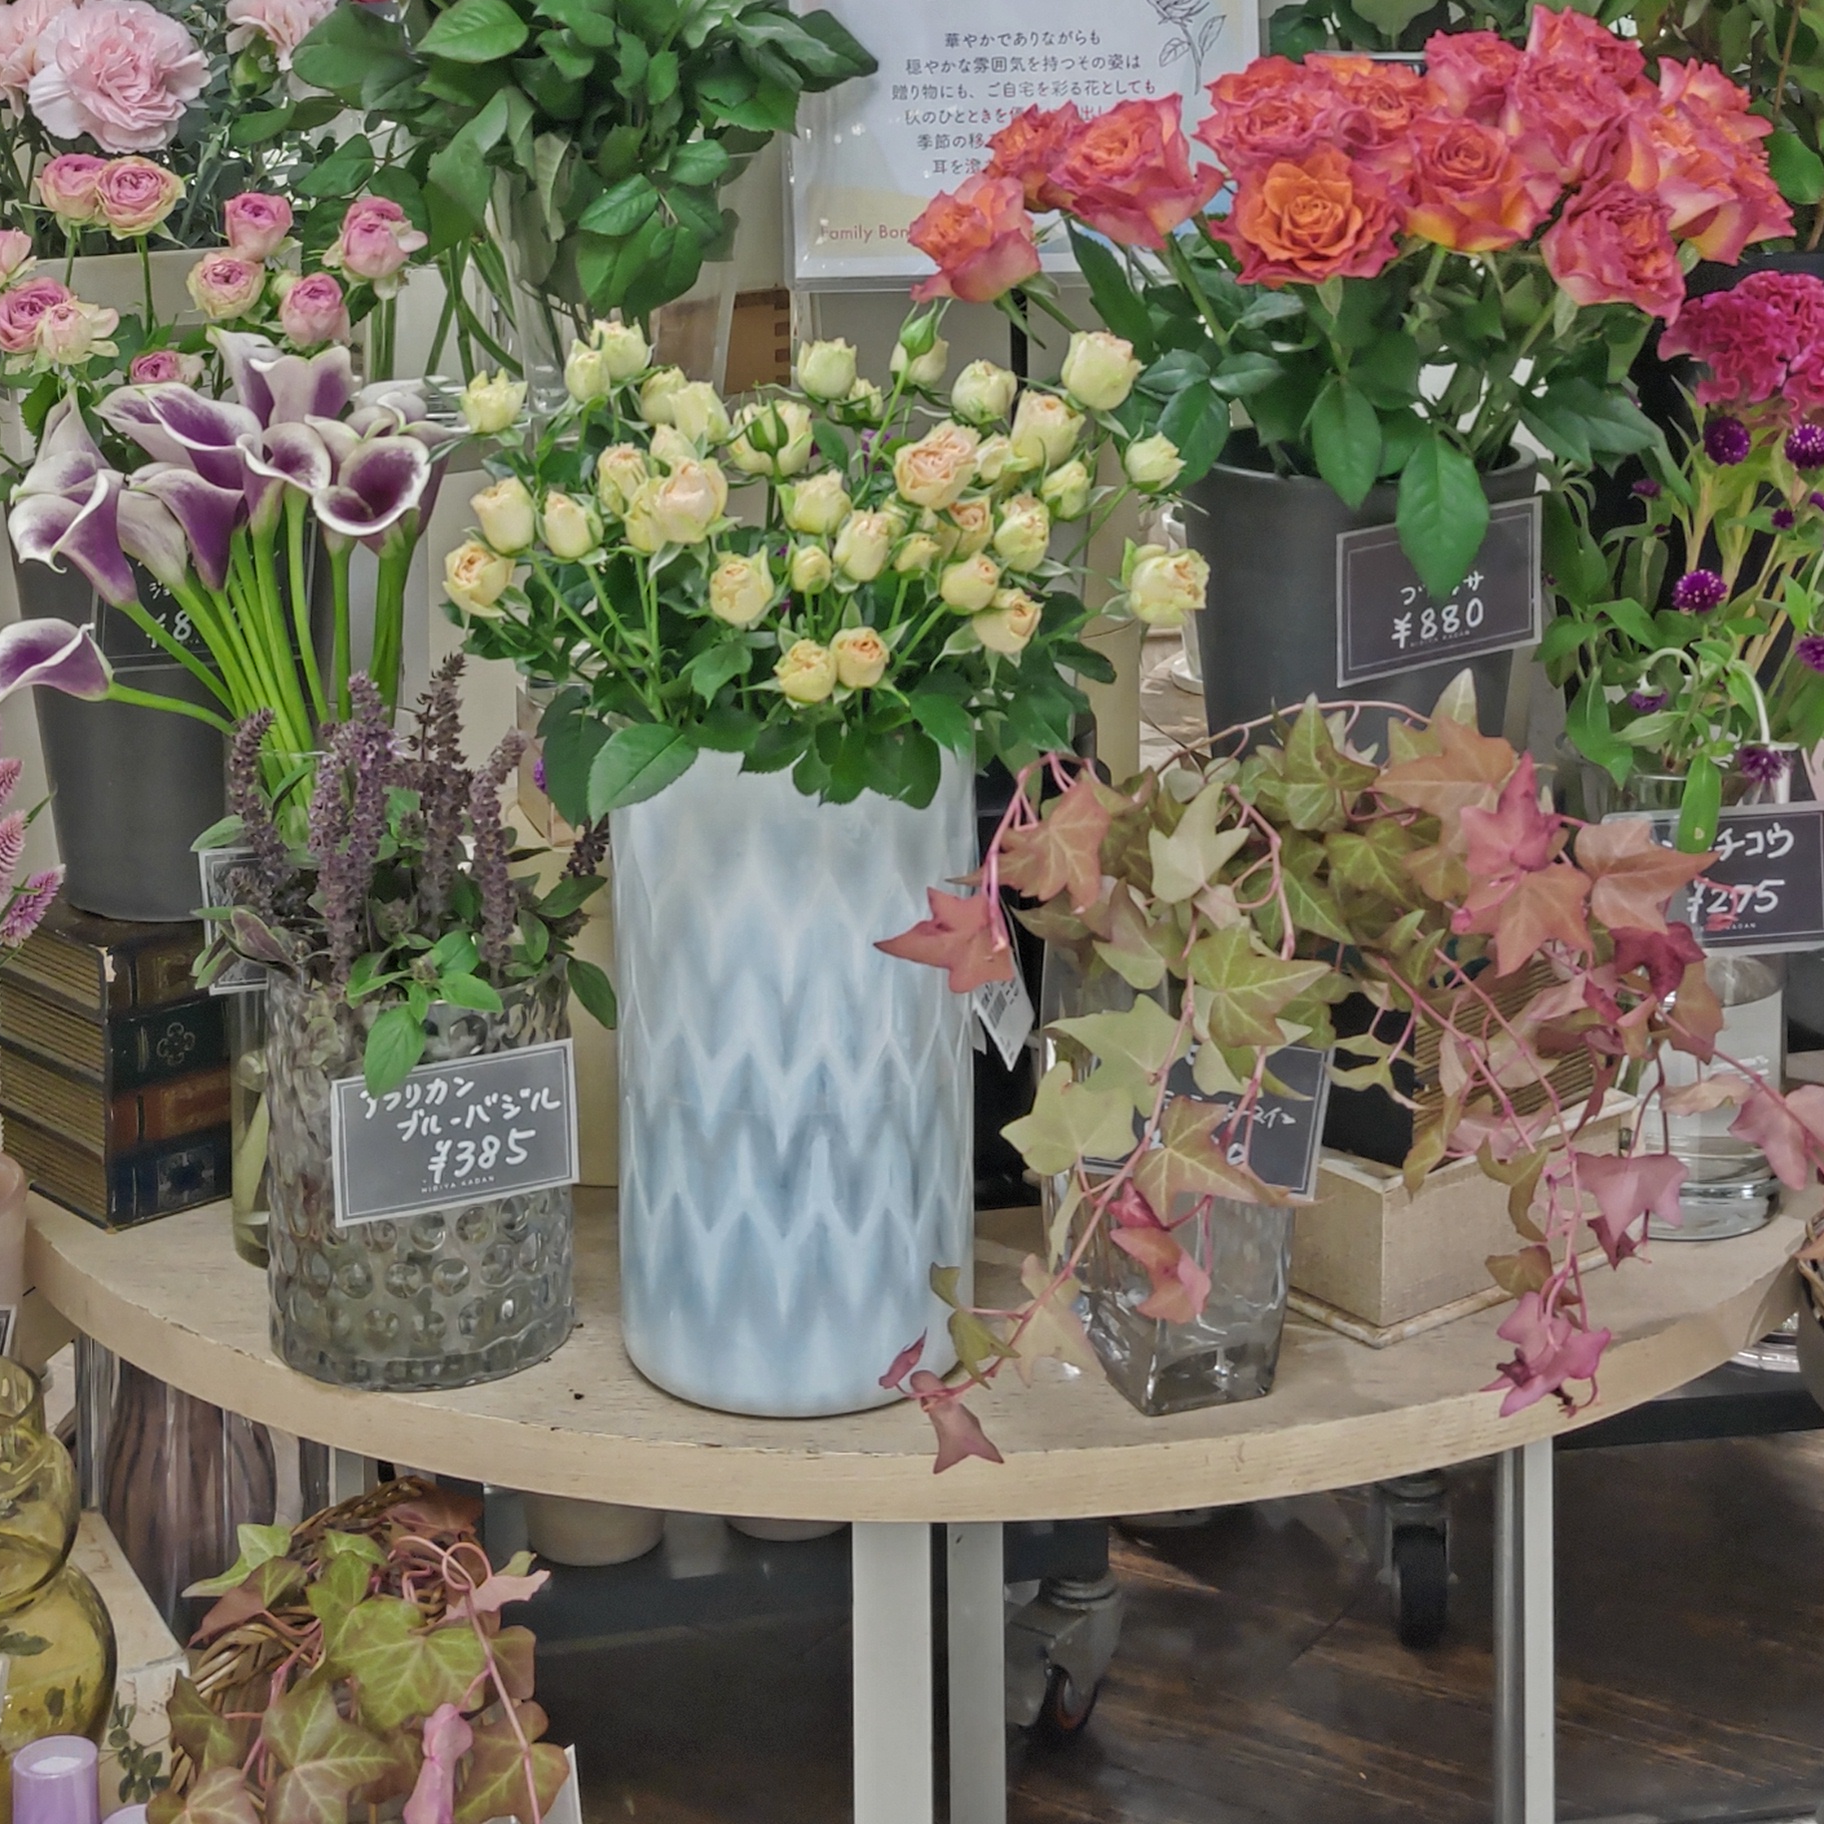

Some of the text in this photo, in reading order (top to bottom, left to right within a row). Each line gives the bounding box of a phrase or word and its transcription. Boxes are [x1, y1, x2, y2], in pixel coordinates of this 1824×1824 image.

[944, 29, 1101, 49] 華やかでありながらも
[905, 53, 1141, 76] 穏やかな雰囲気を持つその姿は
[1391, 597, 1485, 650] ¥880
[397, 1087, 562, 1142] ブルーバジル
[427, 1128, 536, 1185] ¥385
[421, 1174, 496, 1194] HIBIYA KADAN
